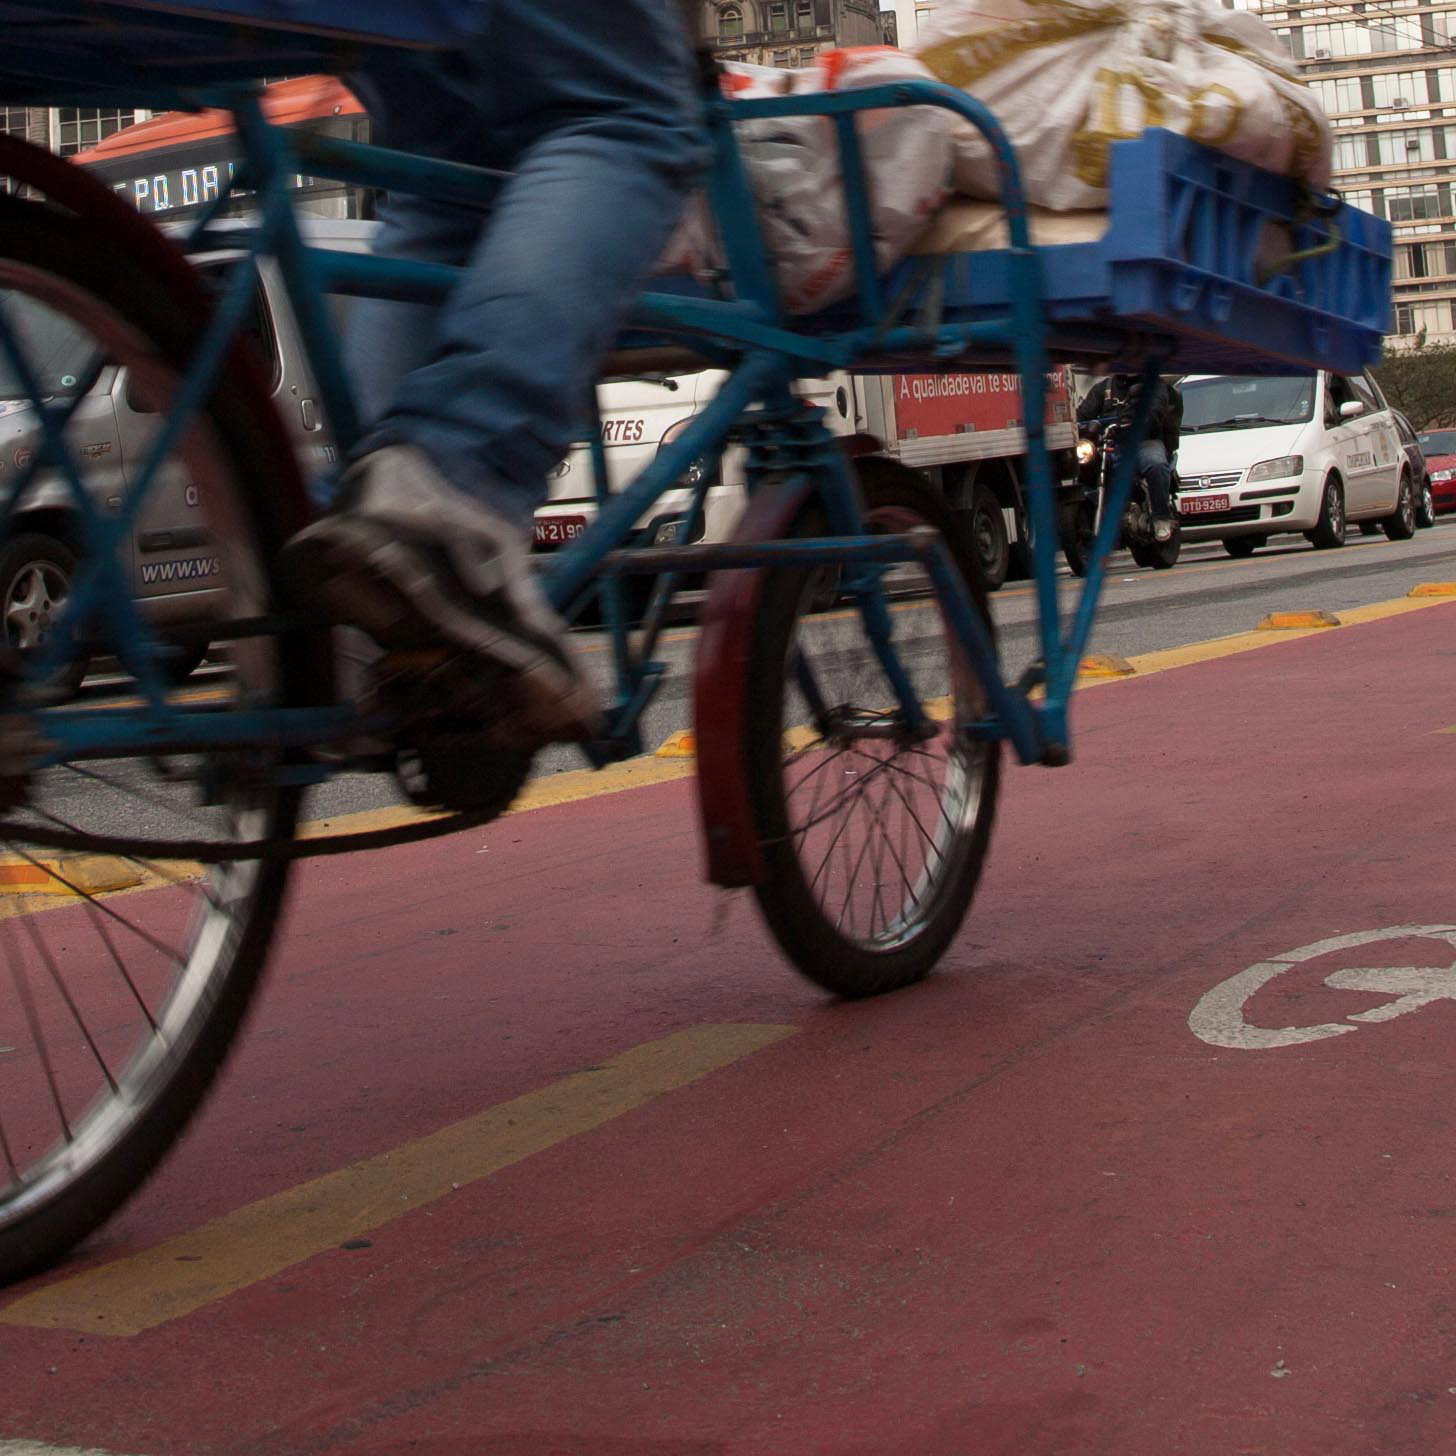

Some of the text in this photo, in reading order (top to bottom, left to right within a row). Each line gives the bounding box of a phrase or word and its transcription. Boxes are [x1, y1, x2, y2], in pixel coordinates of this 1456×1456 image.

[901, 375, 910, 399] A
[912, 374, 969, 403] qualidade
[970, 375, 987, 394] vai
[989, 374, 1000, 393] te
[600, 419, 644, 441] RTES
